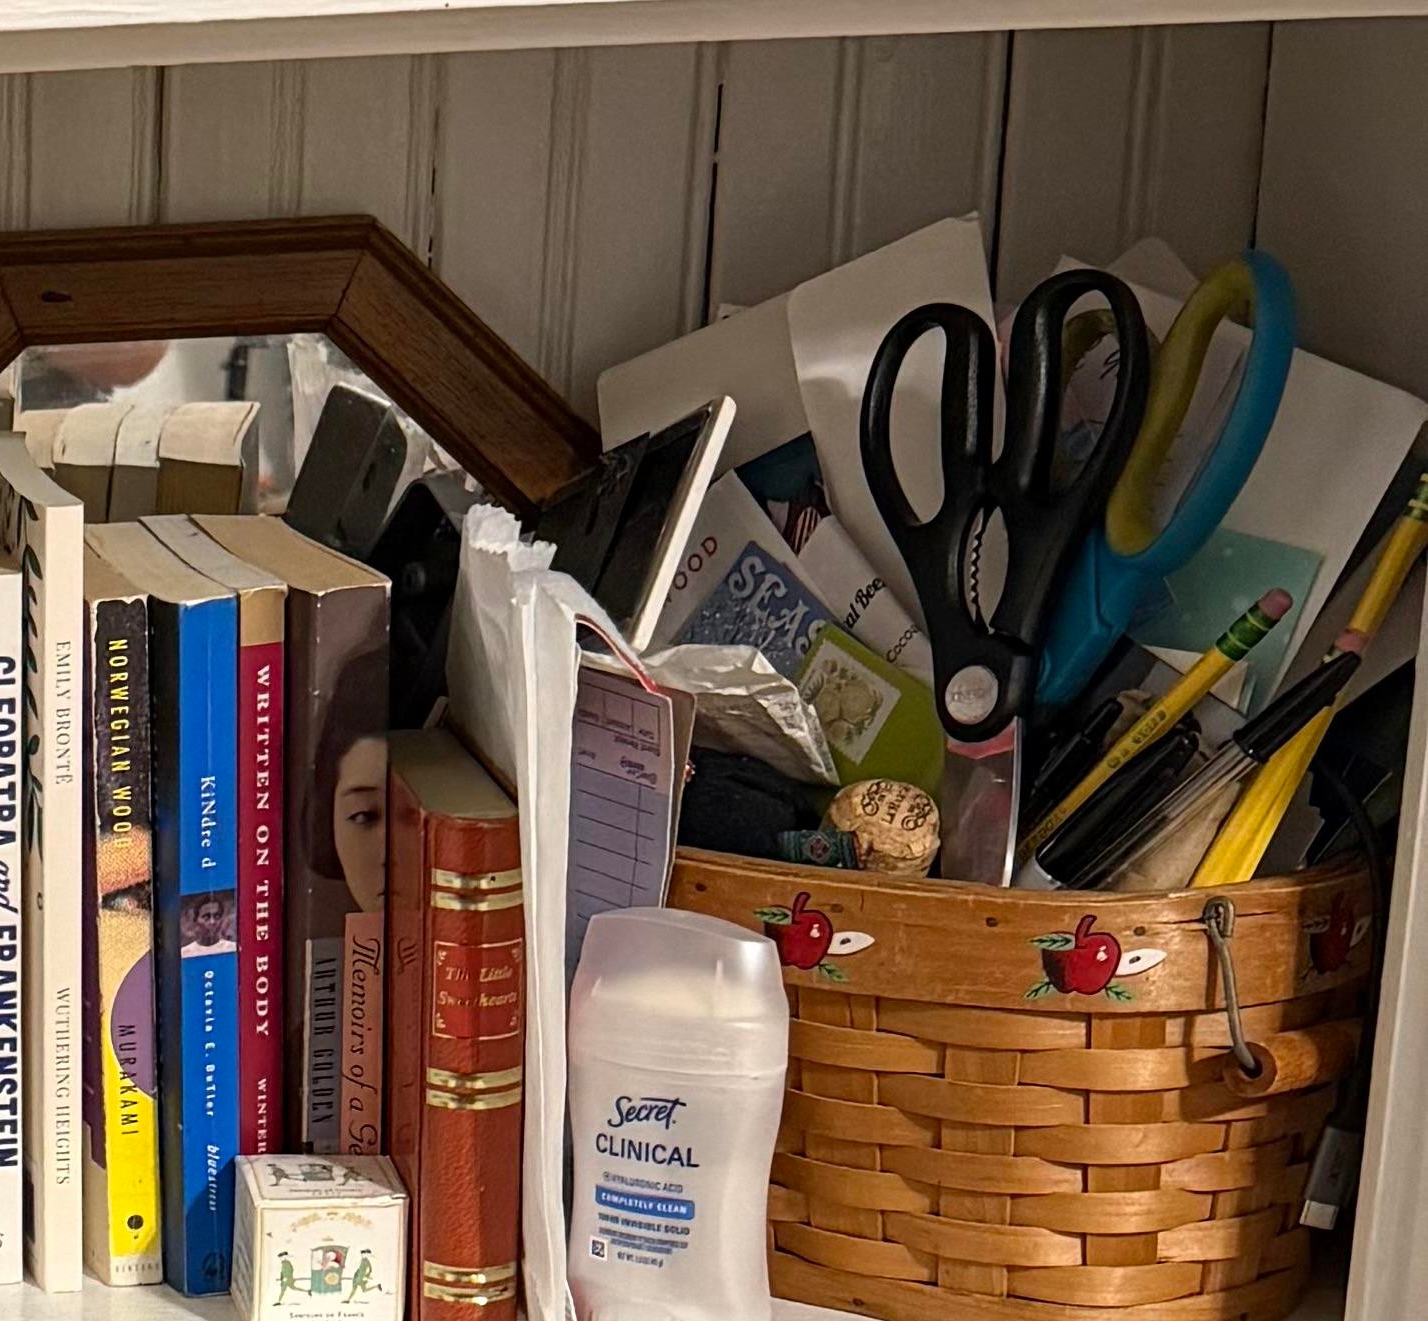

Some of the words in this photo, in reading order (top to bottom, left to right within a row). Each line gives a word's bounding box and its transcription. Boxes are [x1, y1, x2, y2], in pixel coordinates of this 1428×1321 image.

[107, 639, 132, 774] NORWEGIAN
[54, 987, 70, 1103] WUTHERING
[55, 1107, 70, 1186] HEIGHTS
[596, 1133, 700, 1168] CLINICAL
